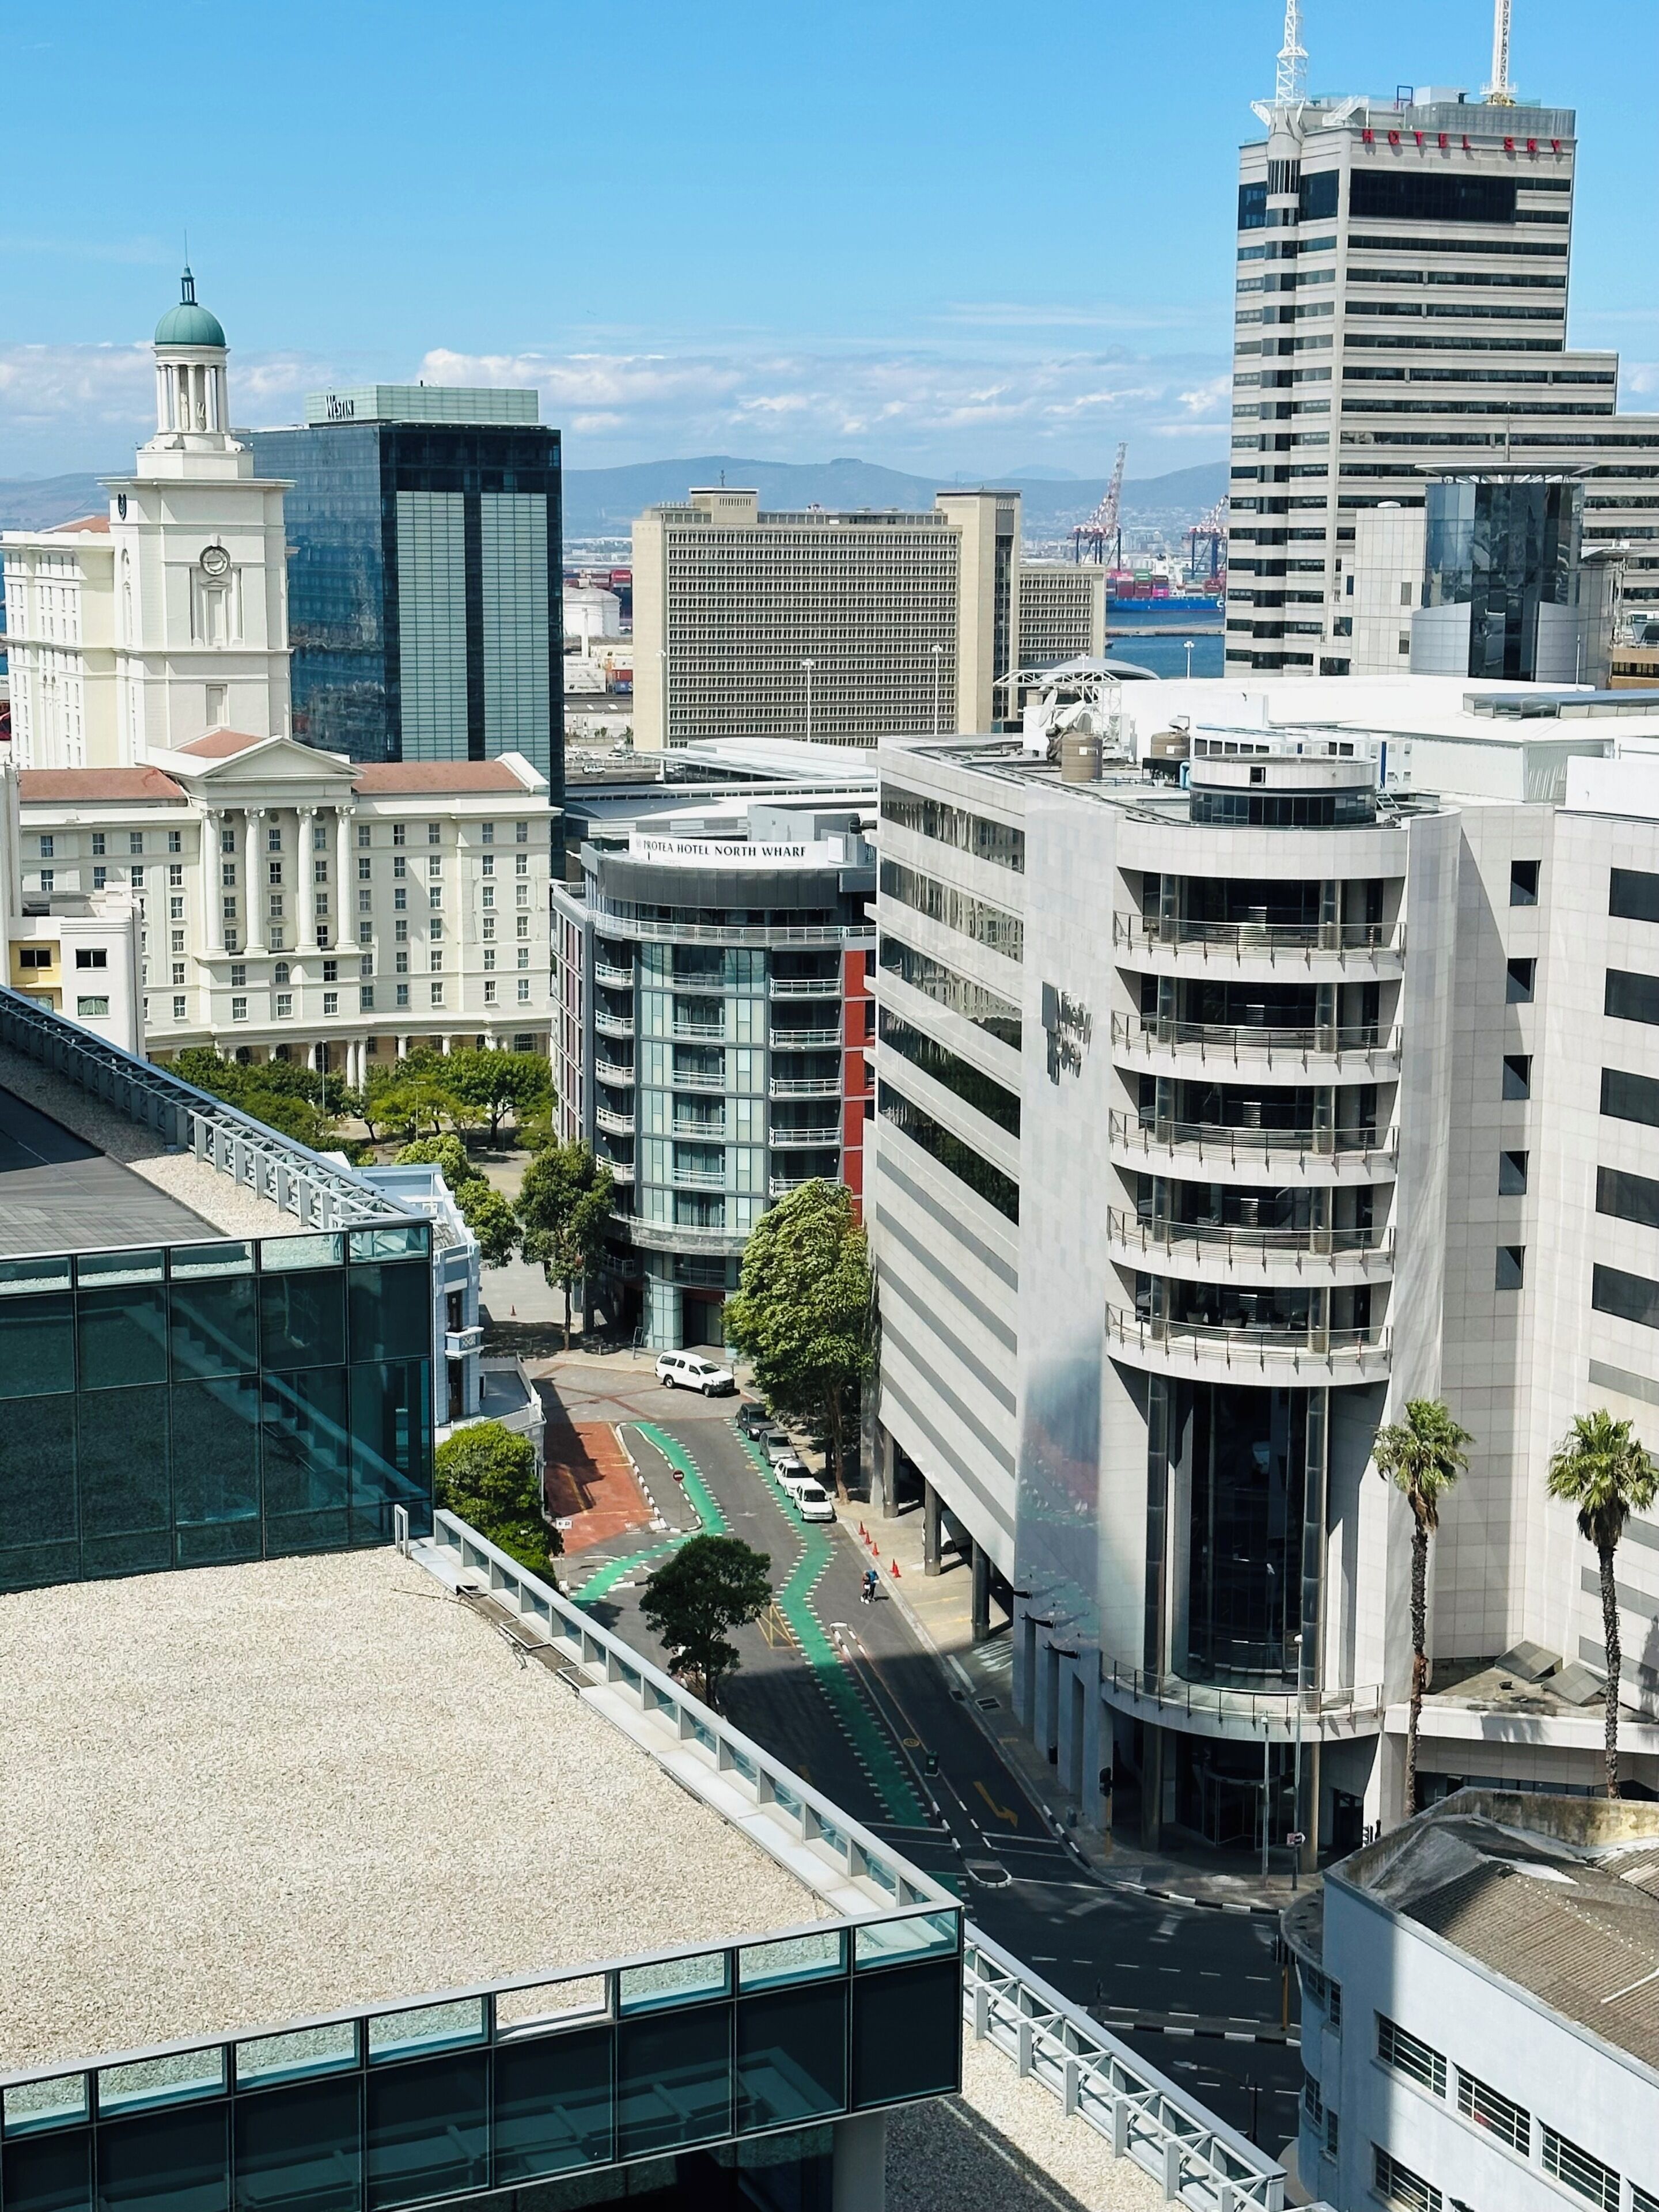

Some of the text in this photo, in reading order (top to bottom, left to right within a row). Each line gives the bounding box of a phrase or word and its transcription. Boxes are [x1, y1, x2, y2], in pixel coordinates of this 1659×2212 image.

[1362, 129, 1562, 153] HOTEL SKY
[643, 840, 806, 857] PROTEA HOTEL NORTH WHARF
